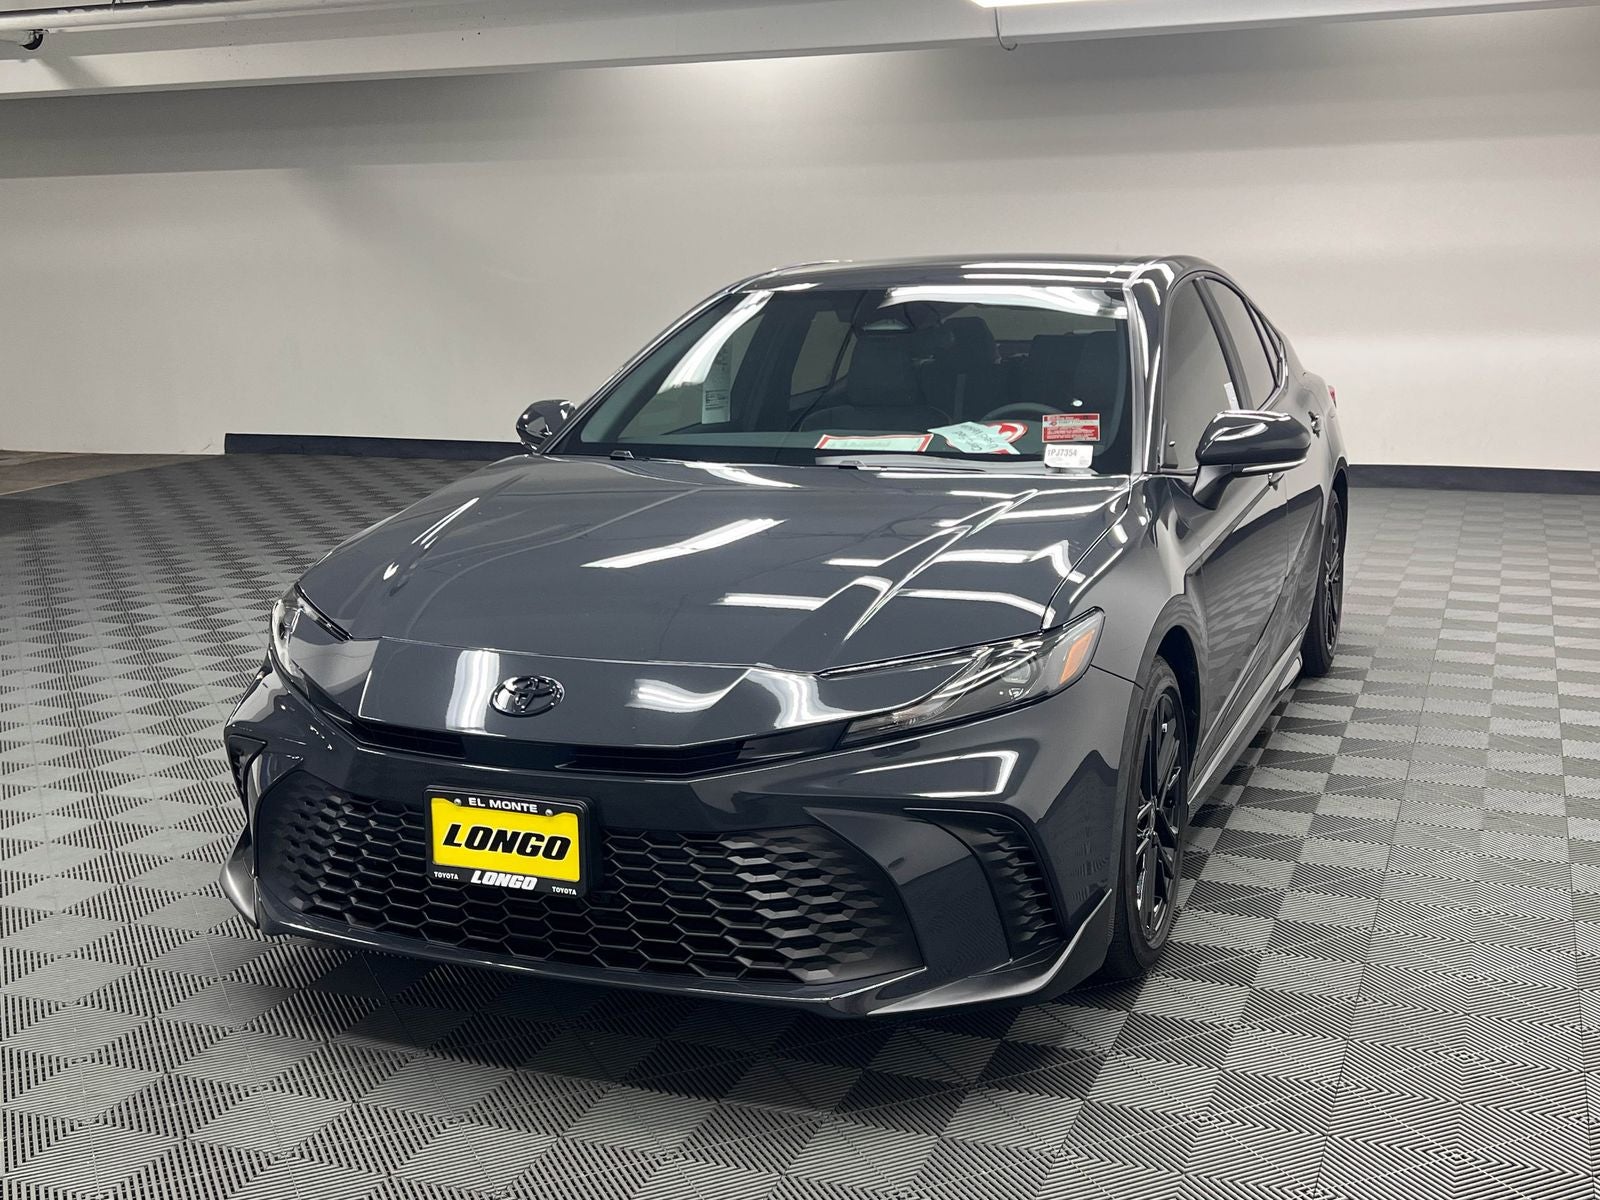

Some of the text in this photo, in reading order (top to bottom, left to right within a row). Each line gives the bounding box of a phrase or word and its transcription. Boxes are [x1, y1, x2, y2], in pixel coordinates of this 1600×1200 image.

[468, 797, 538, 813] EL MONTE
[442, 823, 571, 861] LONGO
[433, 871, 459, 880] TOYOTA
[470, 870, 538, 891] LONGO
[551, 885, 577, 896] TOYOTA
